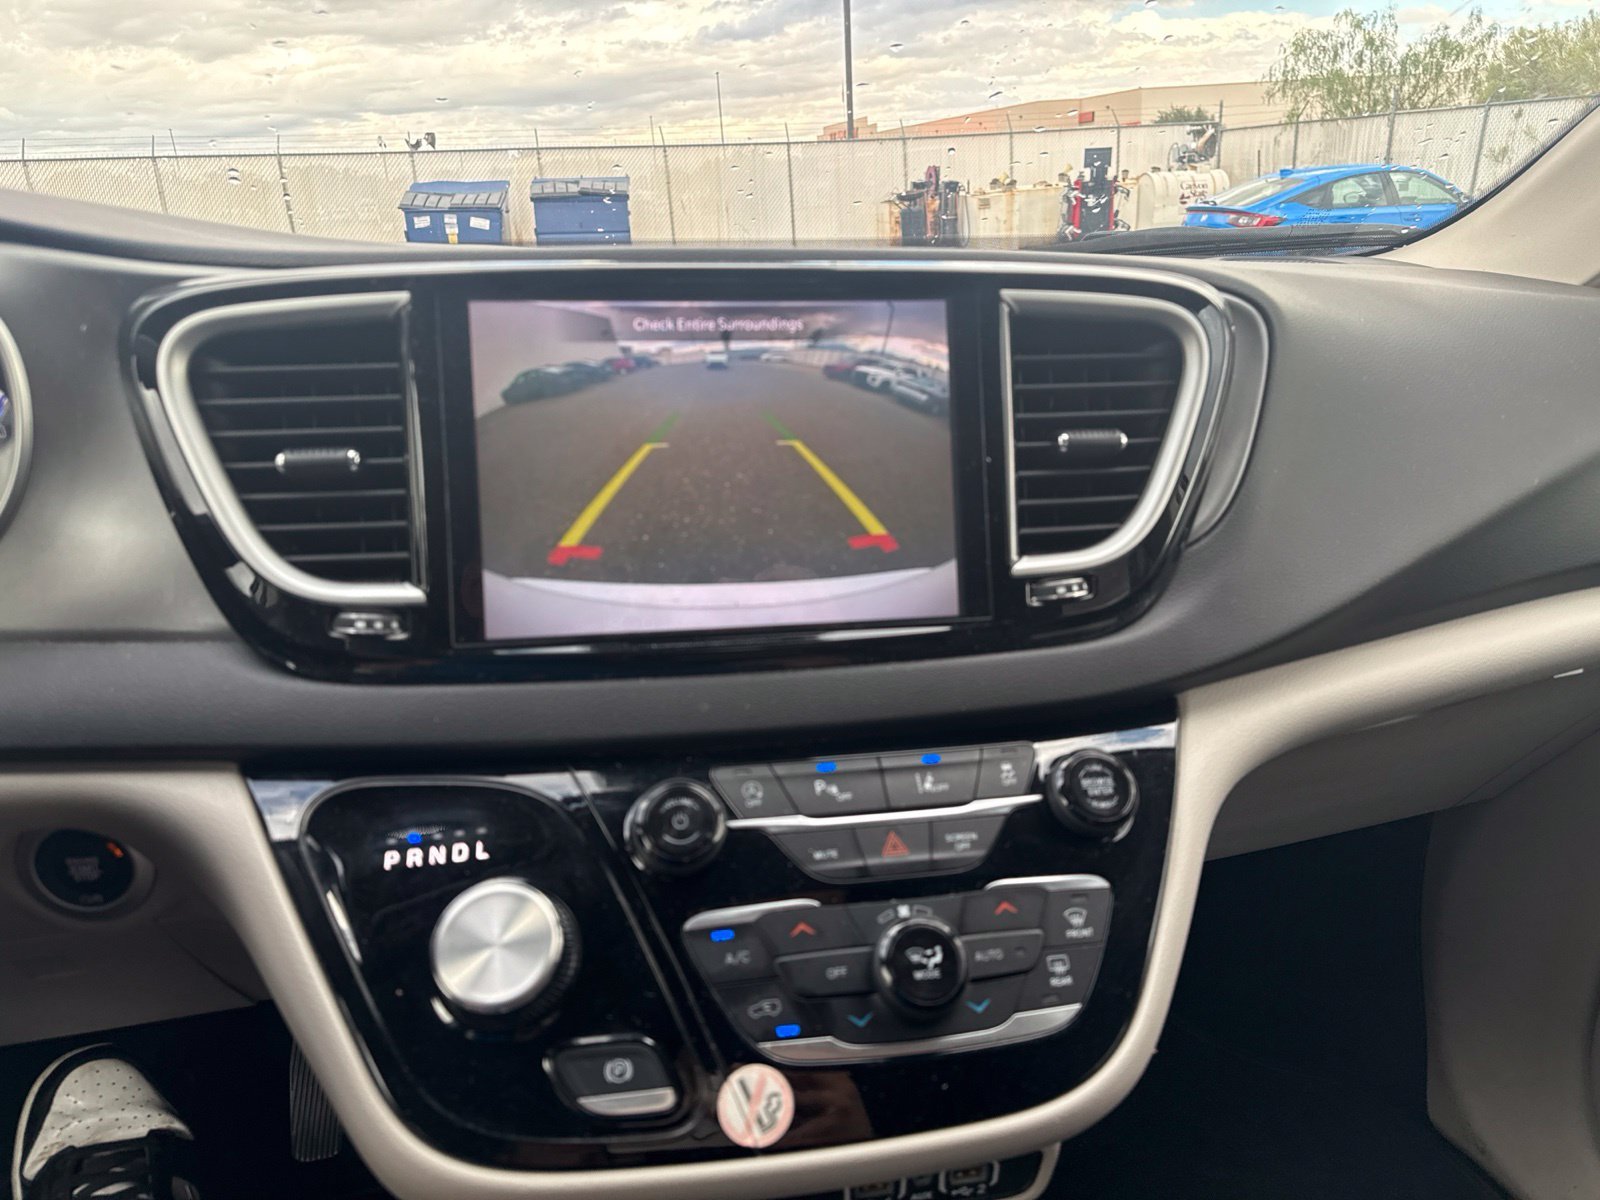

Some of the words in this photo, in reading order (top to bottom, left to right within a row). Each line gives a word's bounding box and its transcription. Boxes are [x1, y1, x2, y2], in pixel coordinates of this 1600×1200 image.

[632, 316, 674, 332] Check
[675, 316, 716, 332] Entire
[717, 316, 804, 334] Surroundings
[724, 949, 751, 965] A/C
[825, 965, 848, 980] OFF
[912, 967, 941, 981] MODE
